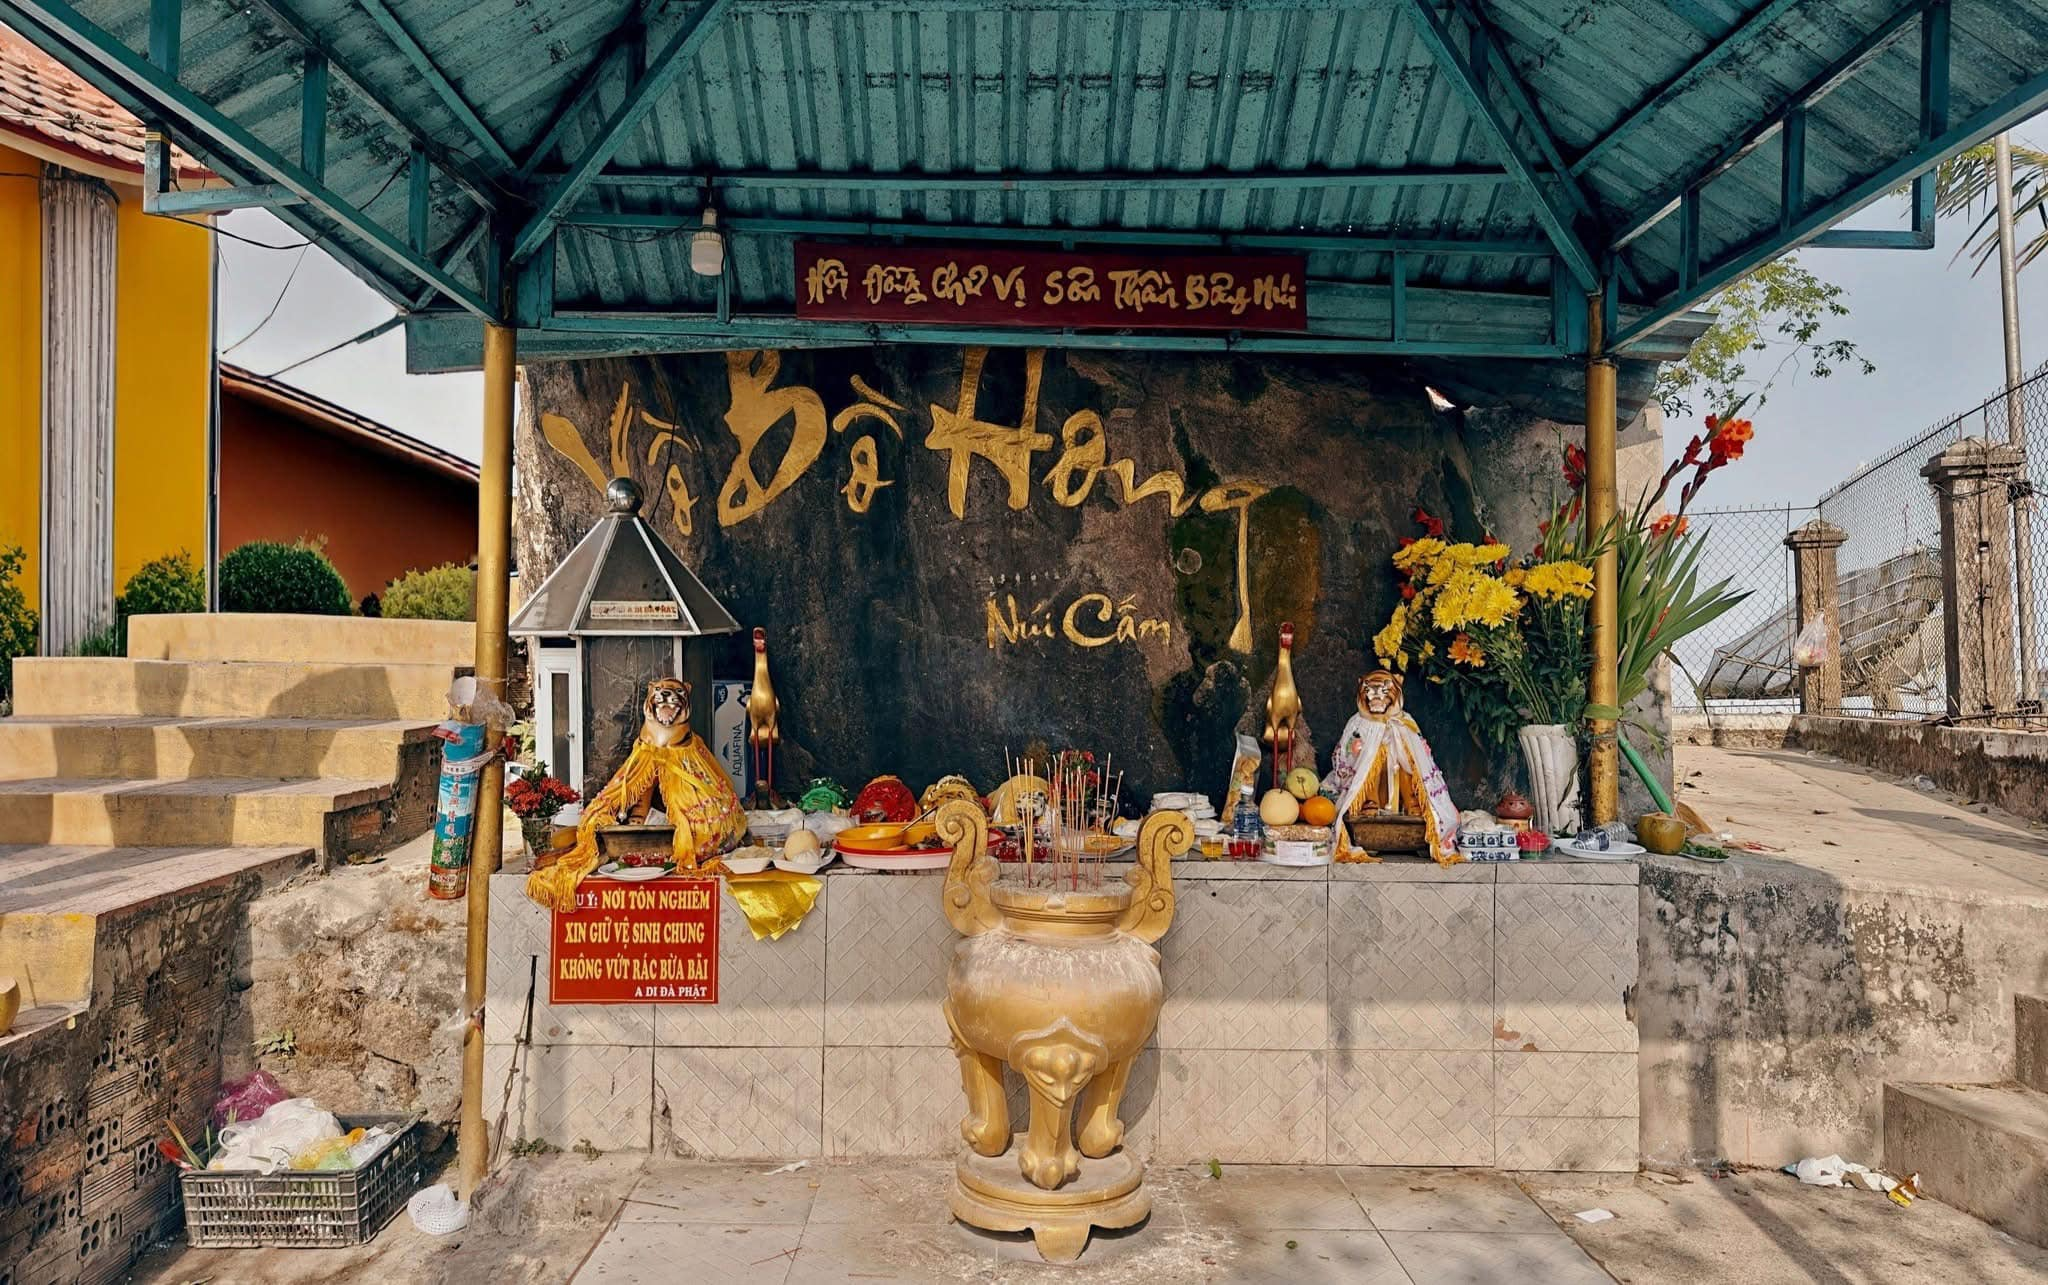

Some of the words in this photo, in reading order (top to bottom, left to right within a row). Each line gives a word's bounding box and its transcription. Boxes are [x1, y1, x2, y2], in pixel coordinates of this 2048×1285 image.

[992, 265, 1026, 308] Vị
[986, 593, 1056, 649] Núi
[1062, 592, 1171, 648] Cấm
[732, 720, 743, 777] AQUAFINA
[602, 887, 626, 910] NƠI
[629, 885, 655, 910] TÔN
[659, 885, 710, 910] NGHIÊM
[565, 921, 587, 943] XIN
[589, 914, 612, 943] GIỮ
[614, 915, 630, 949] VỆ
[632, 922, 661, 943] SINH
[663, 922, 705, 944] CHUNG
[560, 953, 602, 980] KHÔNG
[605, 953, 630, 980] VỨT
[632, 953, 657, 980] RÁC
[660, 954, 685, 980] BỪA
[687, 953, 709, 980] BÃI
[634, 986, 643, 997] A
[645, 986, 658, 997] DI
[660, 984, 675, 997] ĐÀ
[678, 986, 707, 1000] PHẬT
